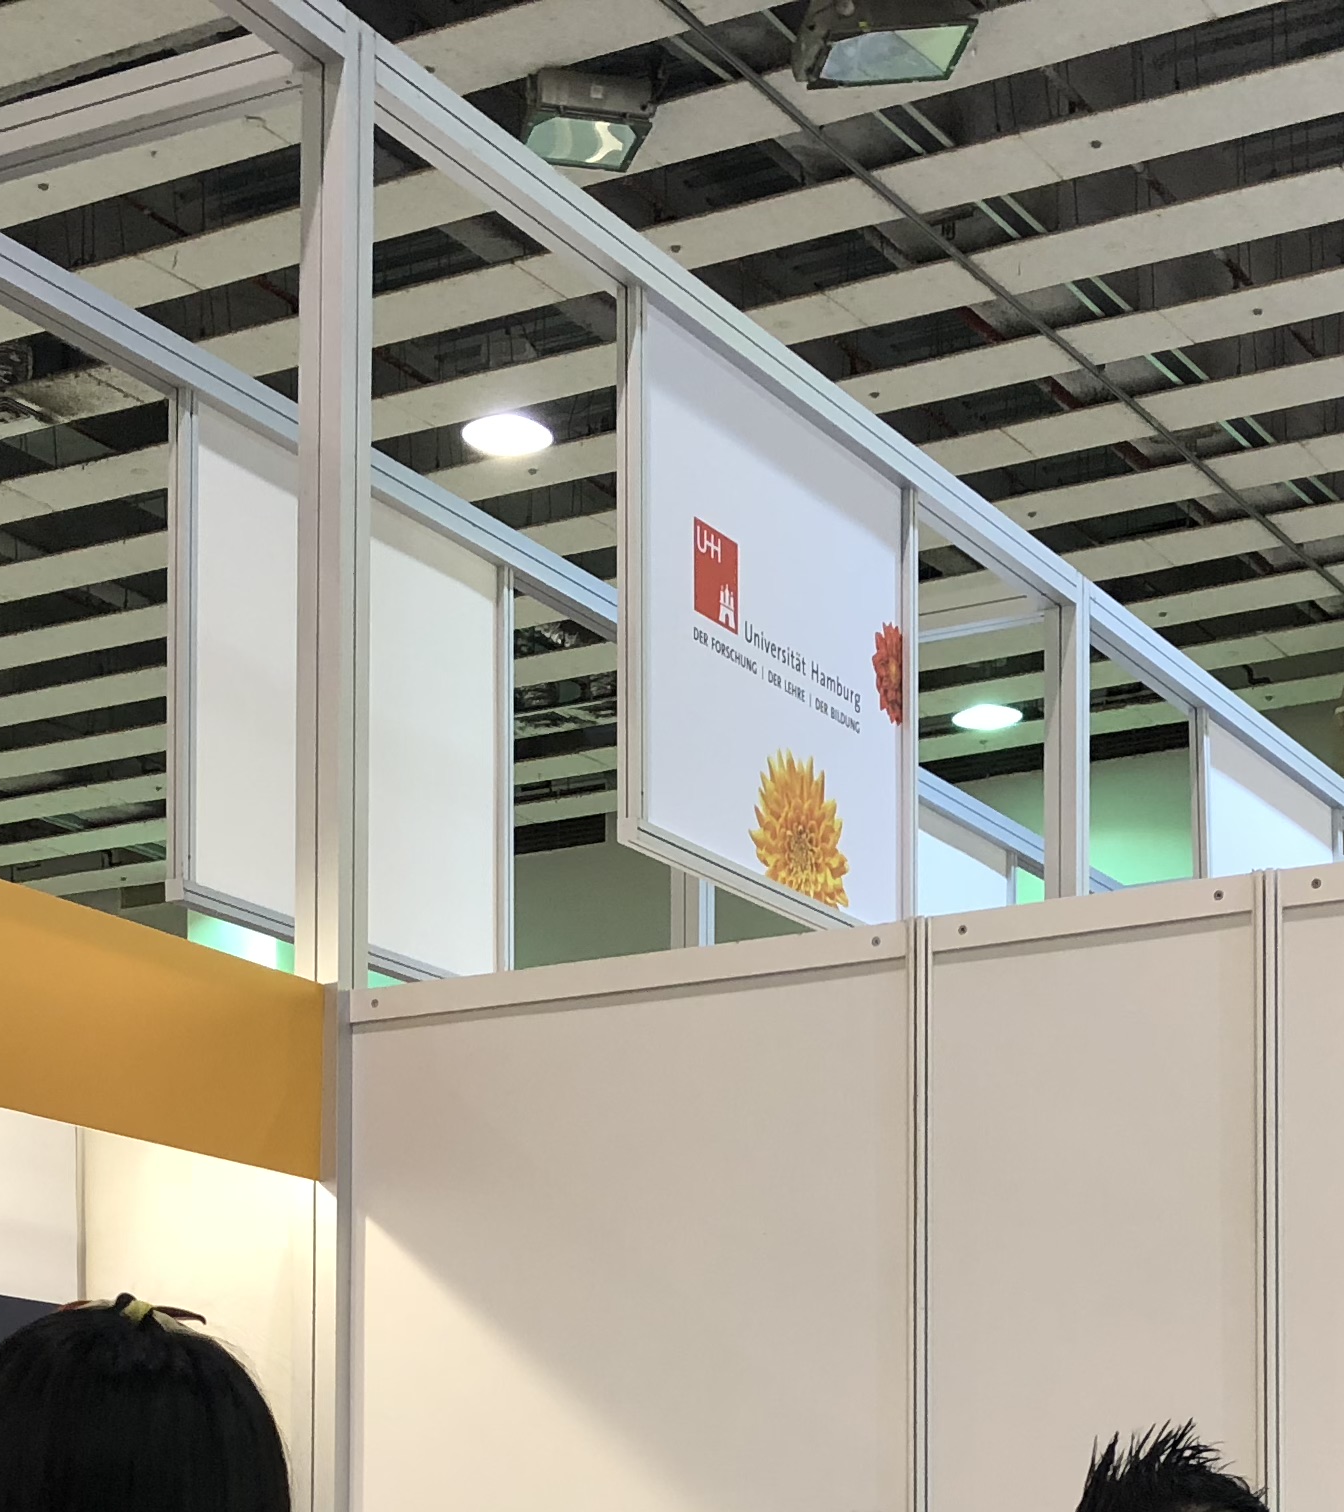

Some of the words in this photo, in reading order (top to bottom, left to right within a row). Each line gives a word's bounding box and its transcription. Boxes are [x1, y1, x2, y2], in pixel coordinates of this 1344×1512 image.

[693, 626, 709, 648] DER
[711, 636, 758, 676] FORSCHUNG
[767, 669, 782, 690] DER
[784, 680, 806, 704] LEHRE
[814, 697, 829, 718] DER
[830, 706, 861, 735] BILDUNG
[744, 620, 807, 677] Universität
[810, 660, 862, 714] Hamburg
